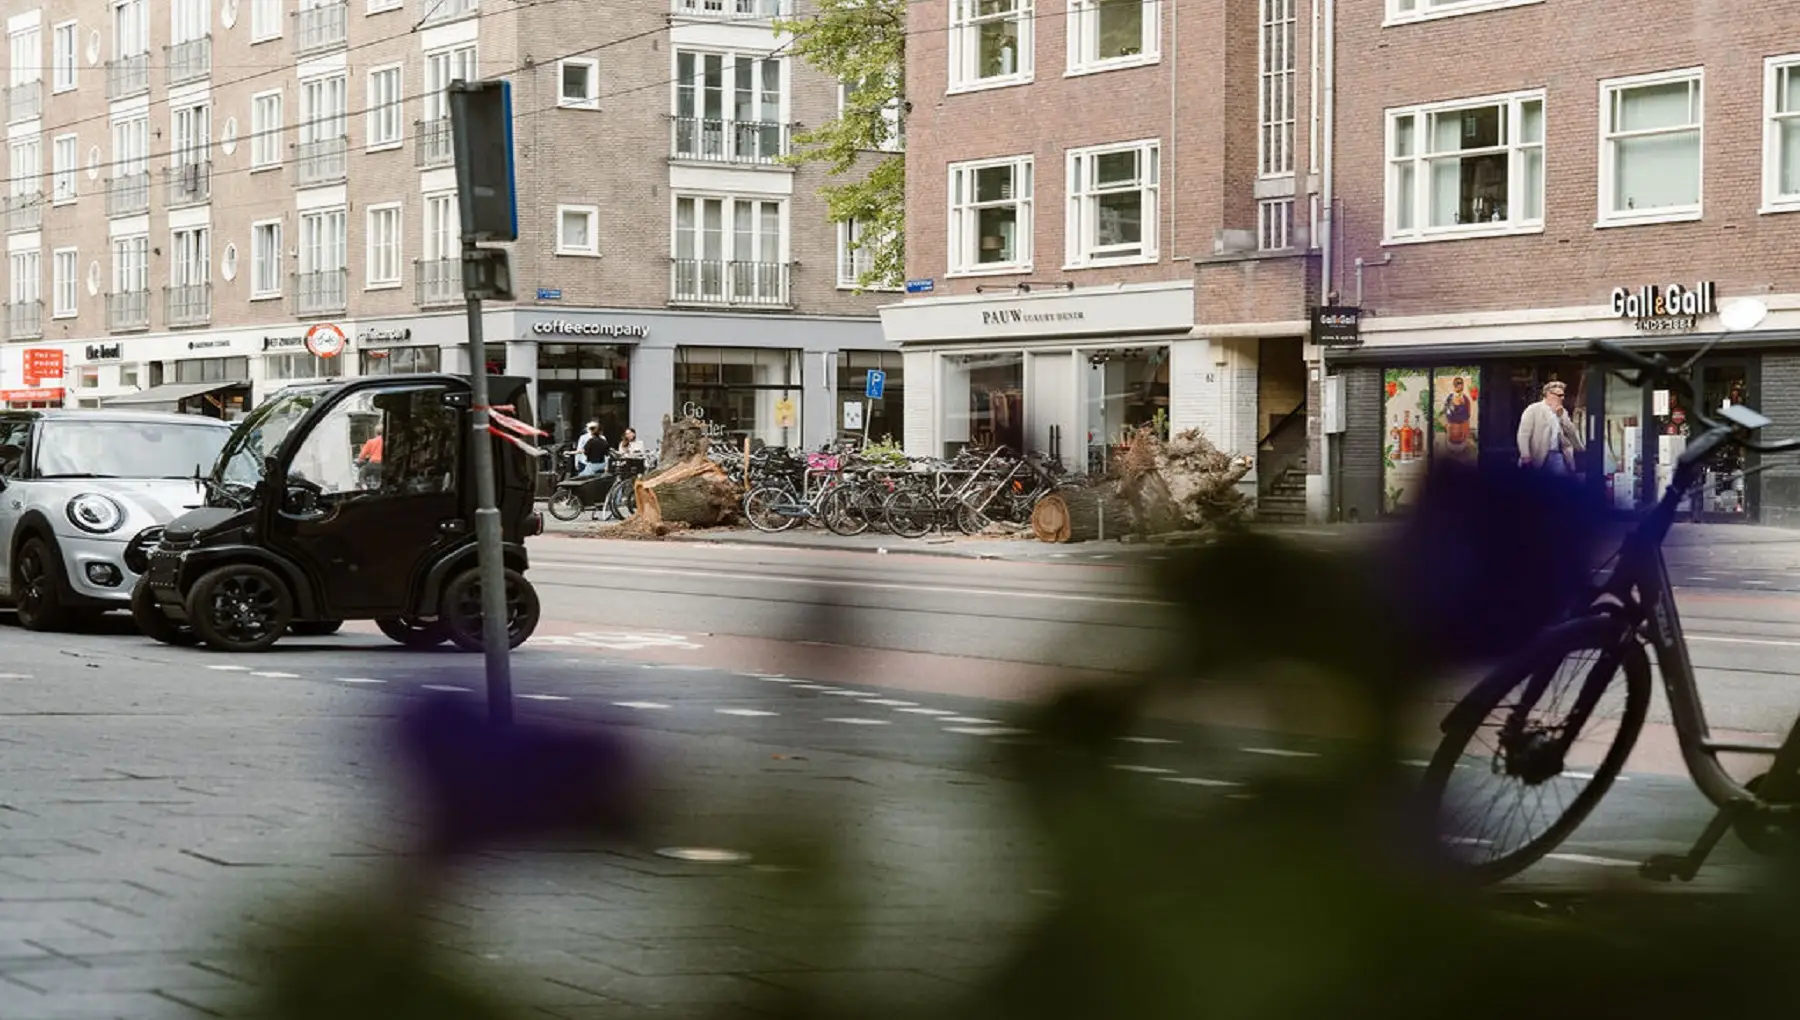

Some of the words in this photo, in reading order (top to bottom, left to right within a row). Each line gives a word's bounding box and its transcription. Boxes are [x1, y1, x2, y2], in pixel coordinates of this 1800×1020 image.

[1611, 281, 1712, 318] Gall&Gall
[982, 308, 1021, 325] PAUW
[533, 320, 650, 338] coffeecompany
[872, 372, 882, 386] P
[683, 401, 704, 419] Go
